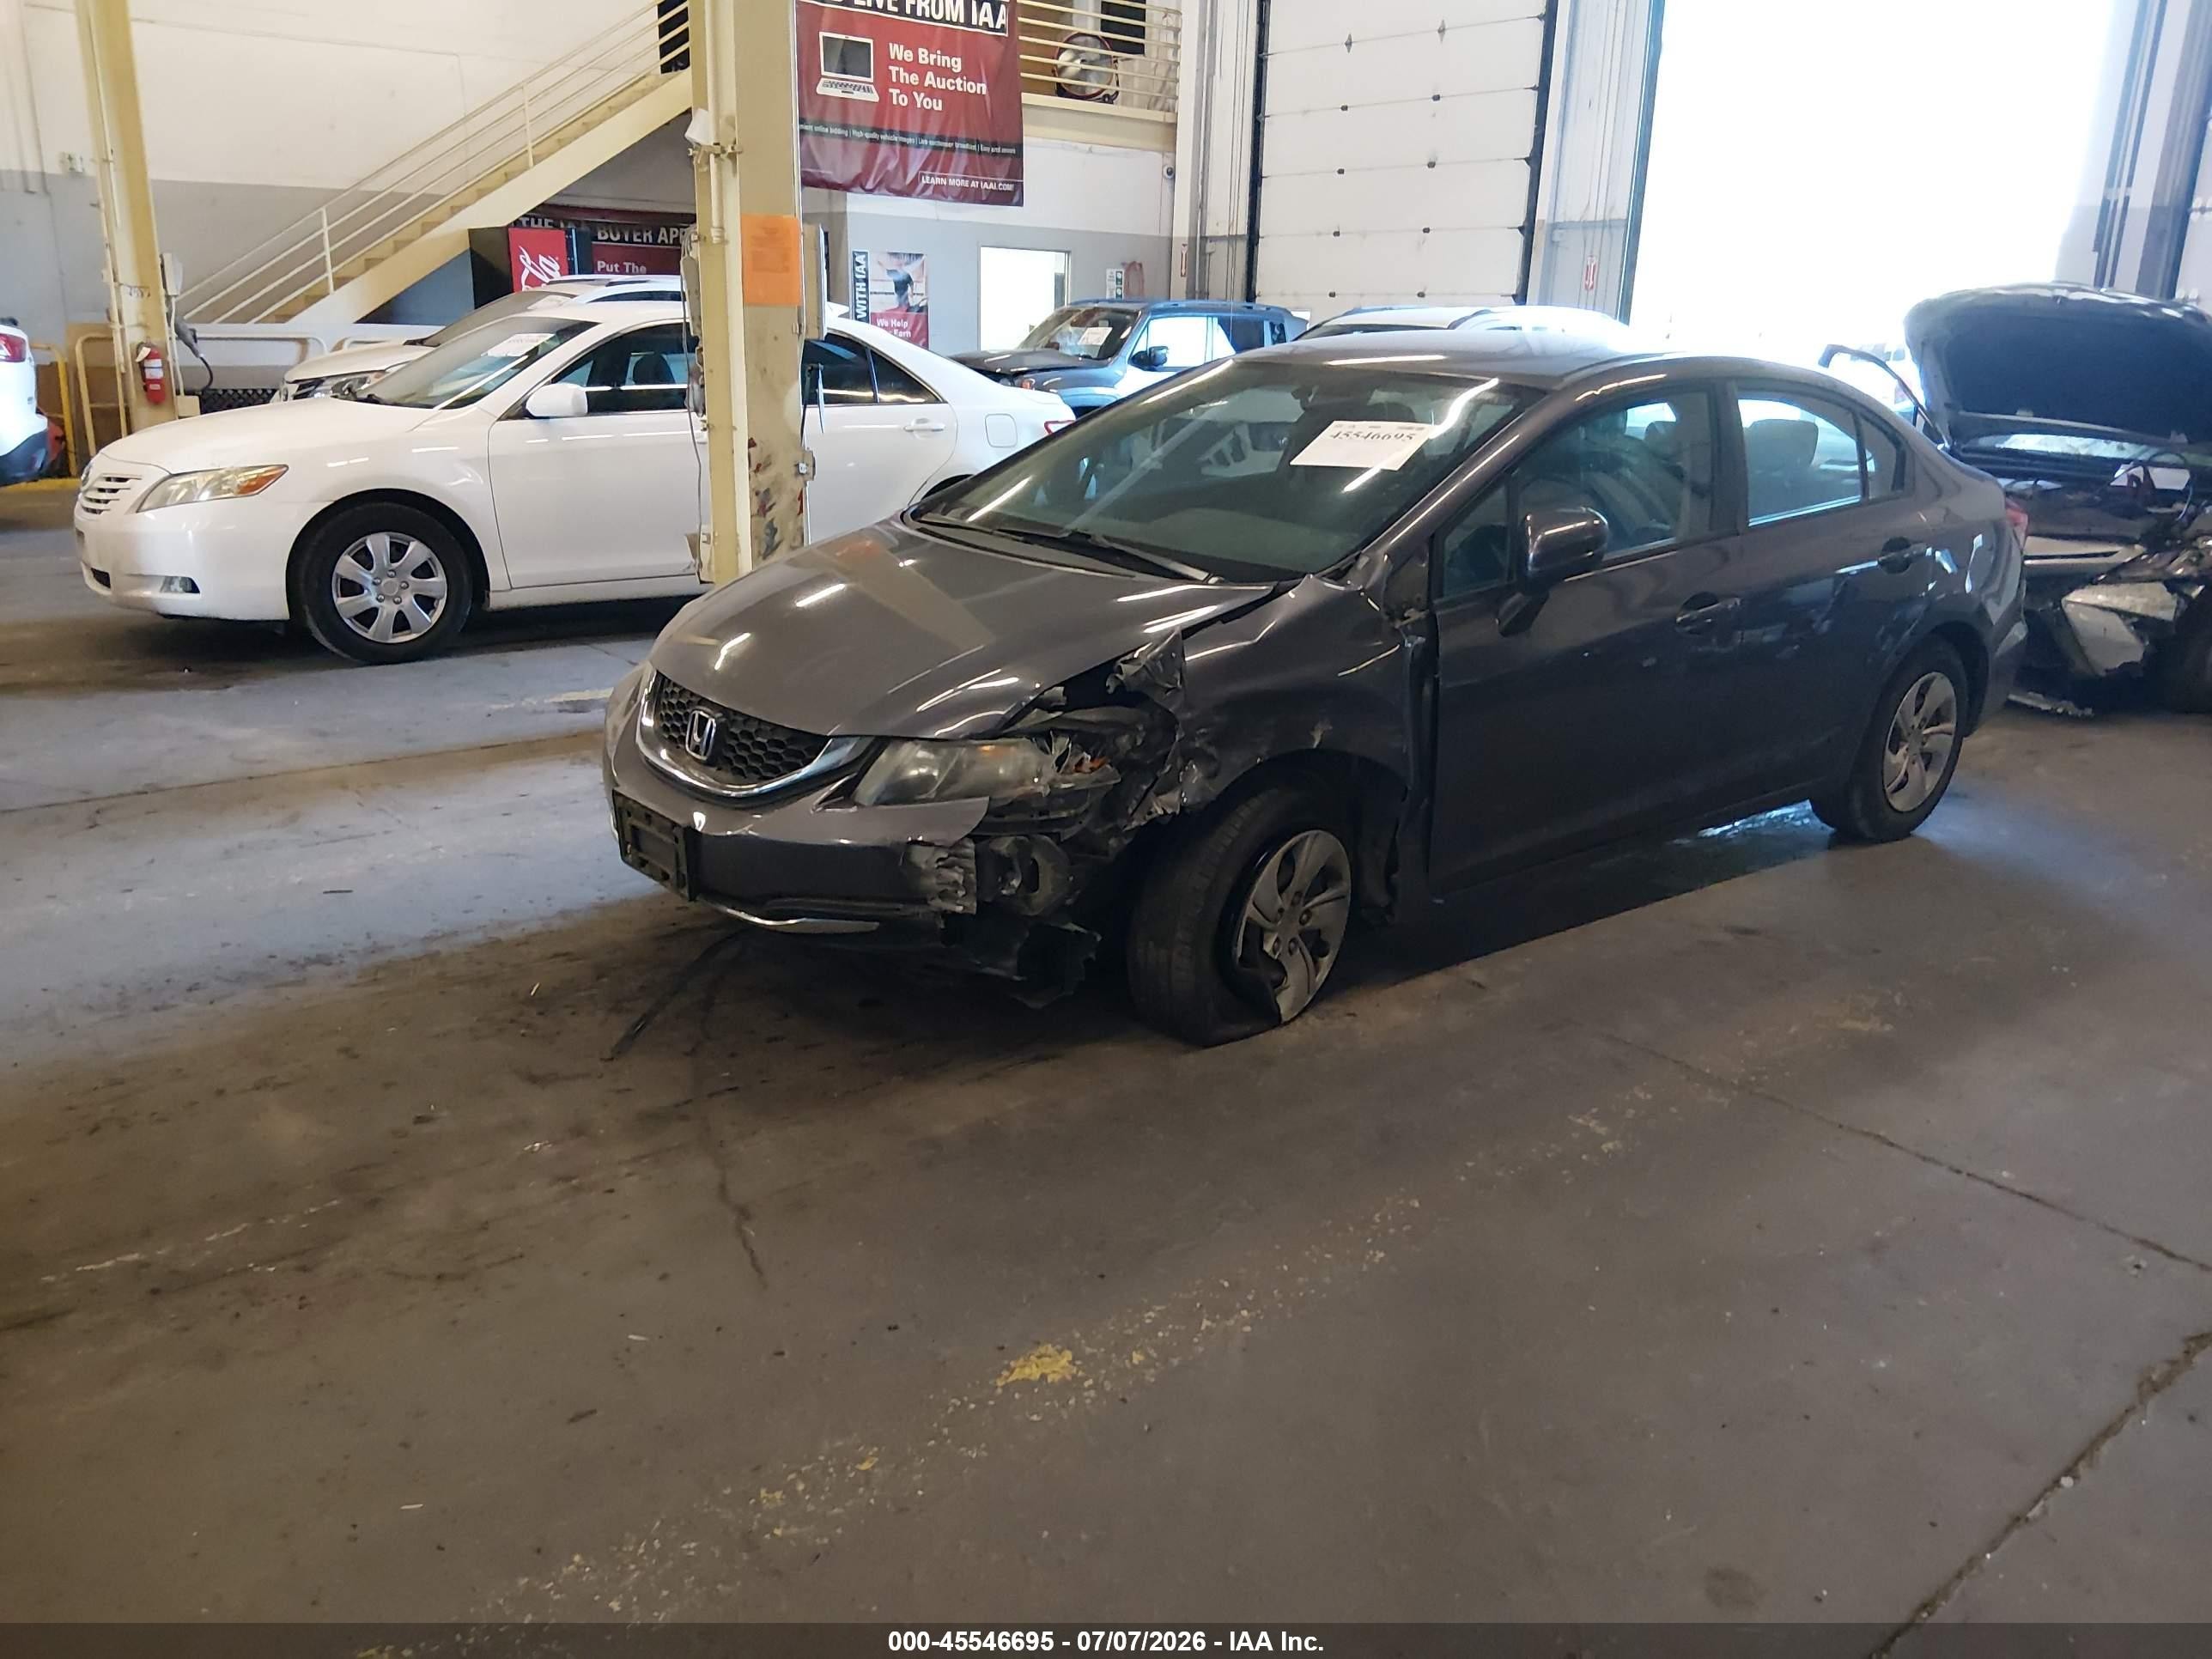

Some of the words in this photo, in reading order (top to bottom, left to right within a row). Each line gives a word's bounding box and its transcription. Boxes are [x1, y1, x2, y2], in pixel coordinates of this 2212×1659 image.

[906, 0, 964, 23] FROM
[972, 0, 1006, 29] IAA
[889, 43, 914, 62] We
[919, 47, 962, 72] Bring
[889, 66, 919, 85] The
[924, 71, 988, 95] Auction
[889, 88, 908, 106] To
[915, 94, 943, 111] You
[921, 175, 947, 186] LEARN
[949, 178, 969, 187] MORE
[971, 179, 980, 188] AT
[597, 225, 653, 244] BUYER
[597, 260, 620, 273] Put
[623, 261, 647, 274] The
[855, 282, 866, 319] WITH
